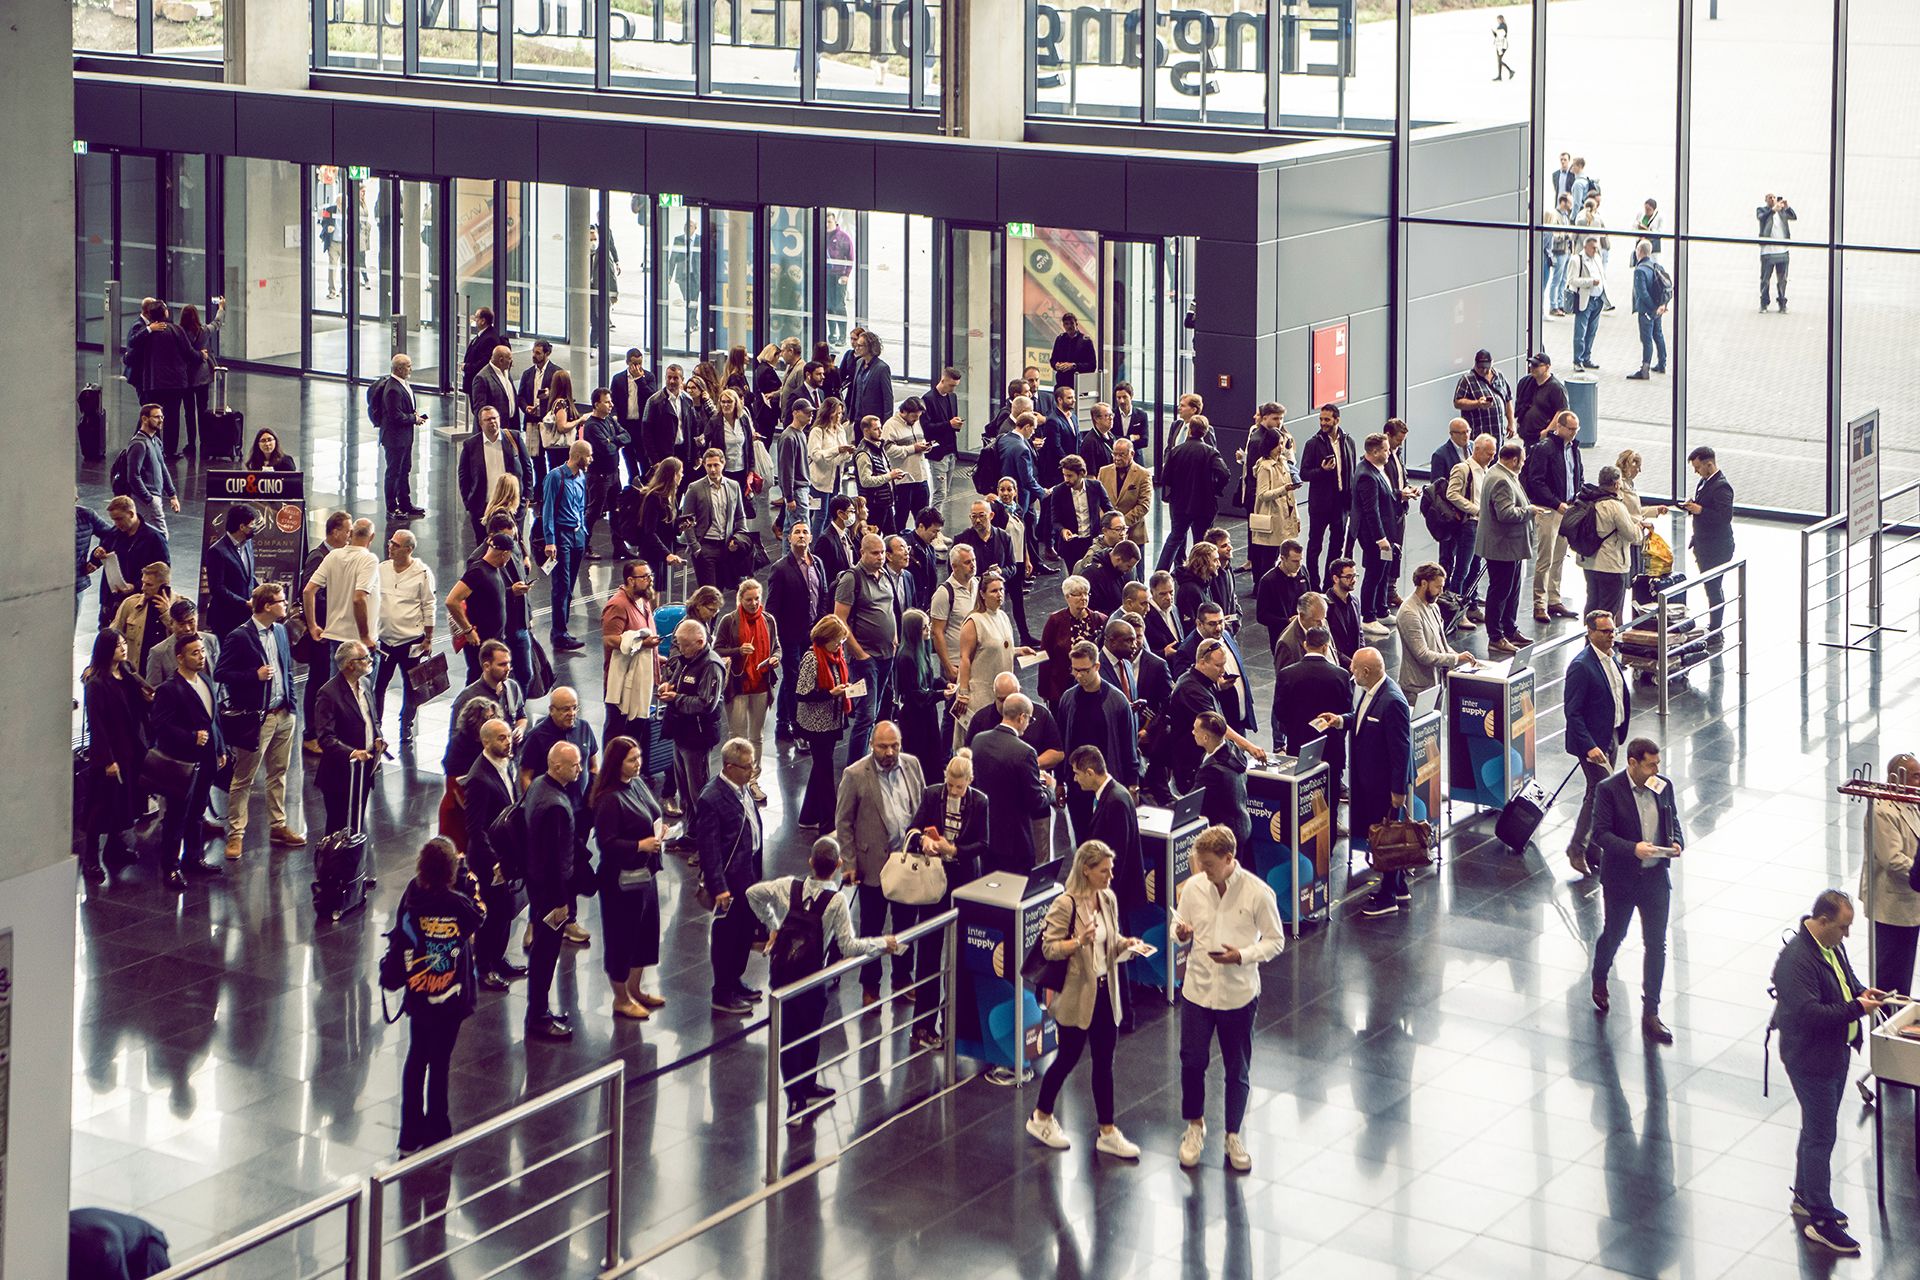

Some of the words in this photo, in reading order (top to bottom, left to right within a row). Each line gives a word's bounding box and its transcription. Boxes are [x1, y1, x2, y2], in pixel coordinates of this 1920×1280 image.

[1462, 706, 1486, 717] supply
[1025, 904, 1050, 924] InterTab
[968, 936, 995, 950] supply
